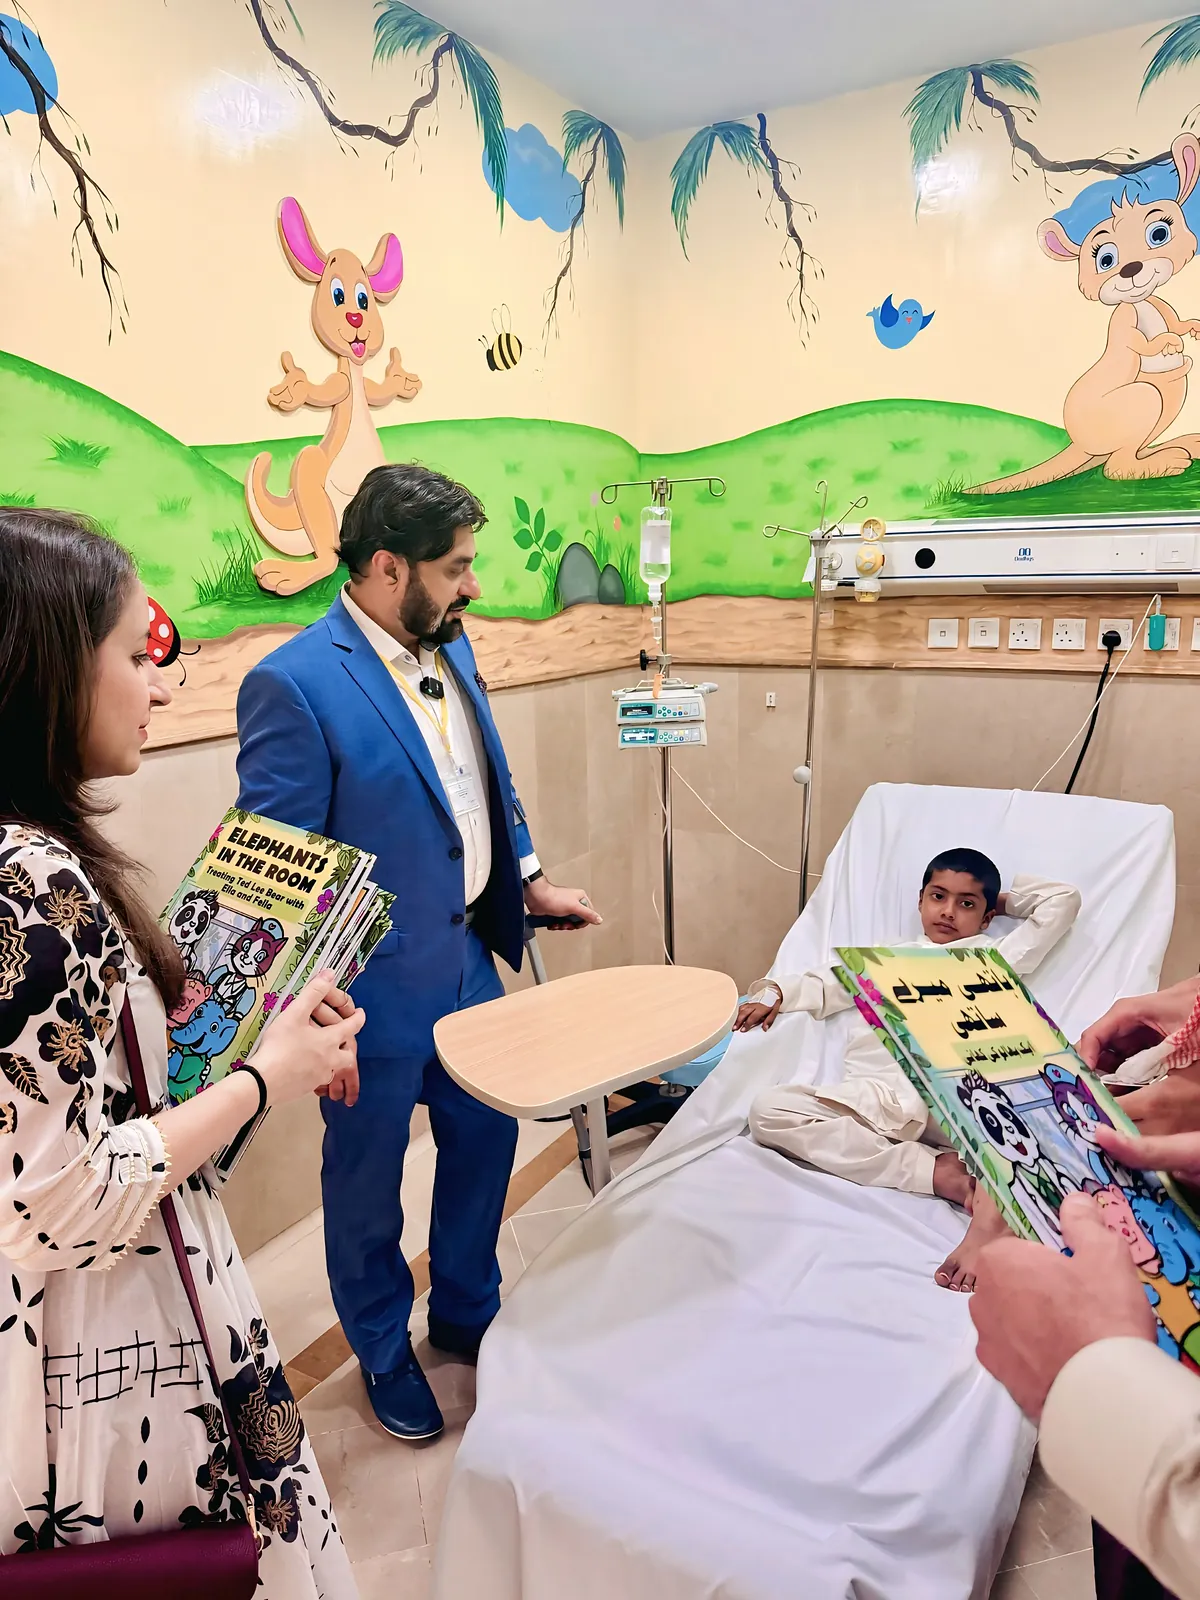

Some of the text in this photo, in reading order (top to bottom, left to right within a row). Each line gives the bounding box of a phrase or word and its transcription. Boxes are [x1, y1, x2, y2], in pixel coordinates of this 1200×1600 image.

[216, 847, 316, 893] IN THE ROOM
[227, 827, 328, 874] ELEPHANTS
[206, 866, 305, 910] Treating Ted Lee Bear with
[221, 884, 273, 910] Ella and Fella
[892, 977, 953, 1004] میرے
[951, 1005, 1007, 1039] ساتھی
